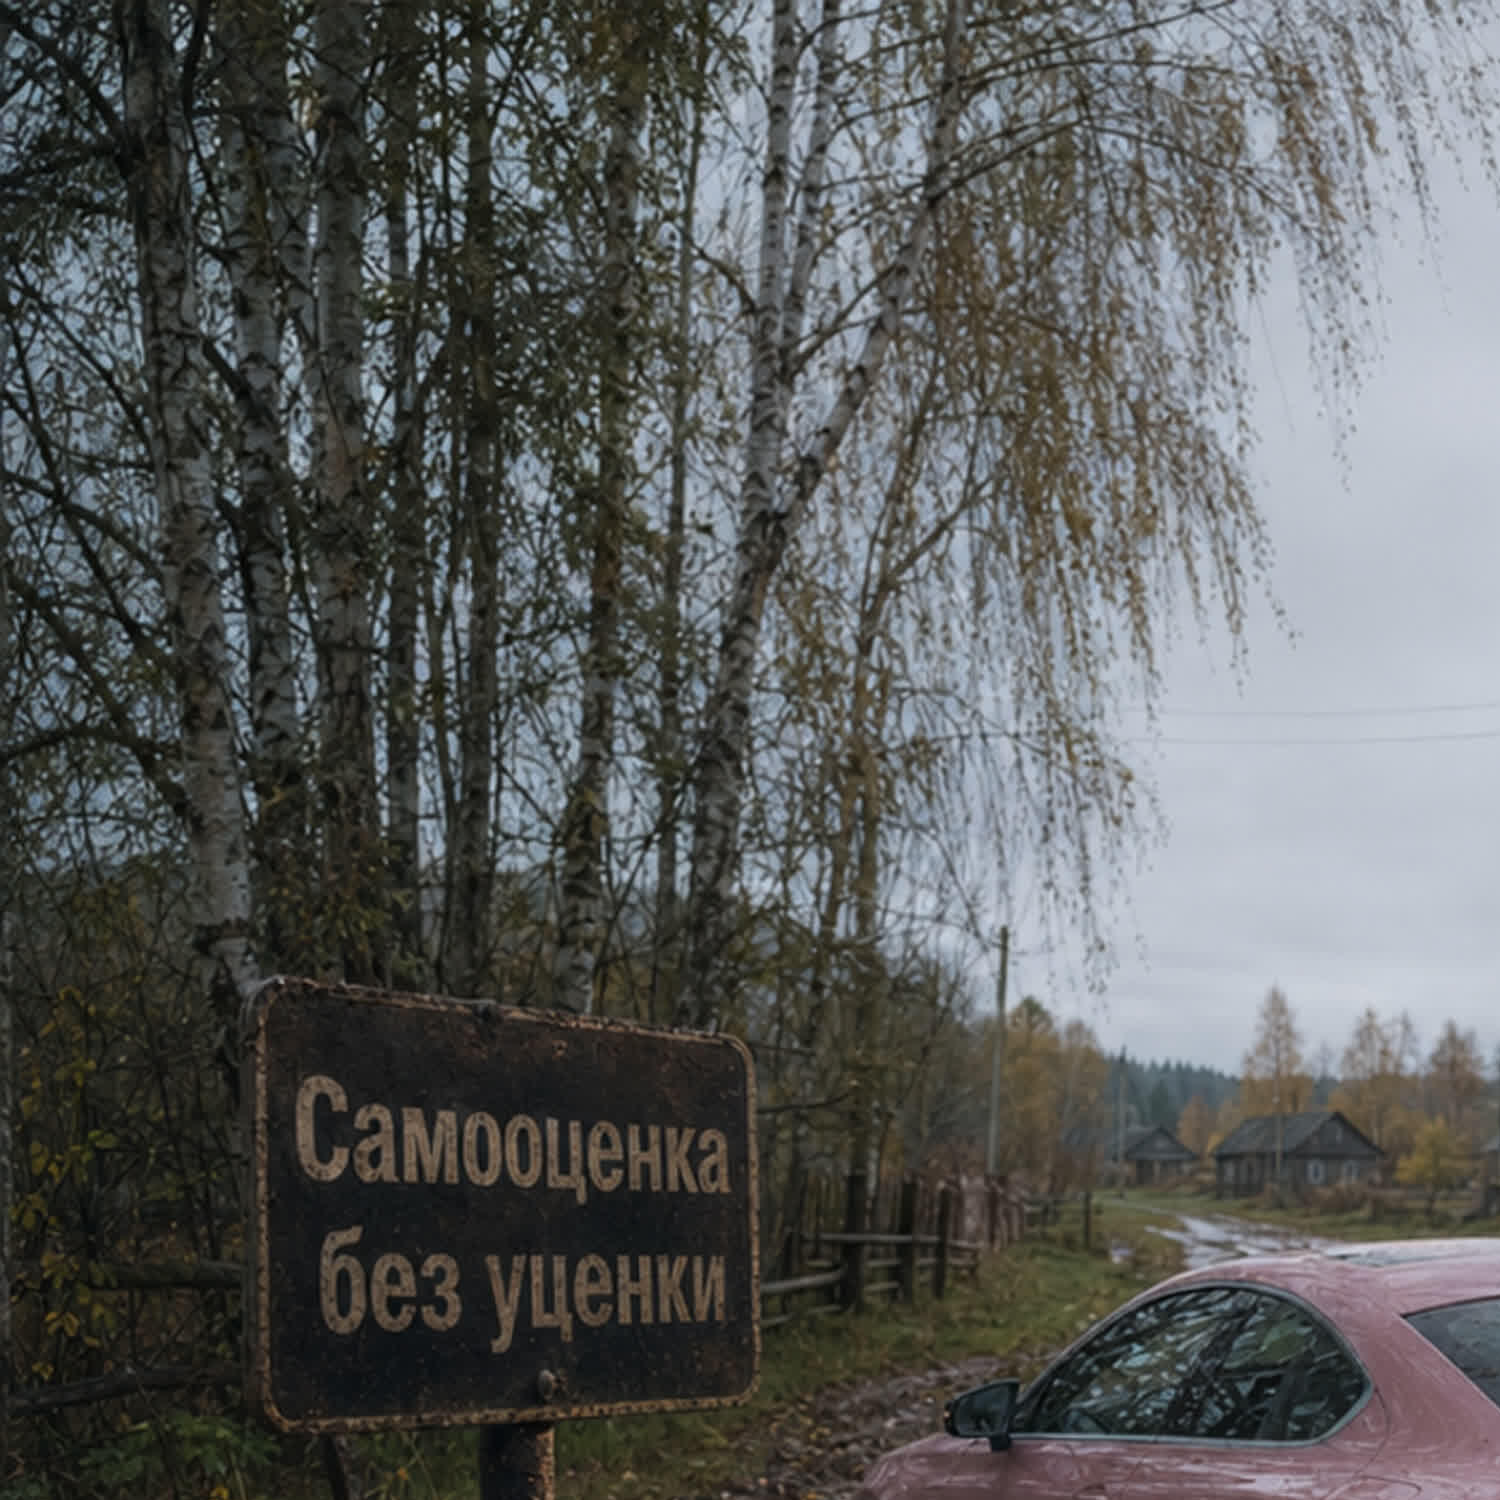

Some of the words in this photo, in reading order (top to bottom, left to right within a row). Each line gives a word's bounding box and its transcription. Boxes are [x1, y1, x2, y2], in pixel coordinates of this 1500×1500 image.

[295, 1074, 731, 1205] Самооценка
[319, 1225, 462, 1336] без
[484, 1253, 726, 1354] уценки
